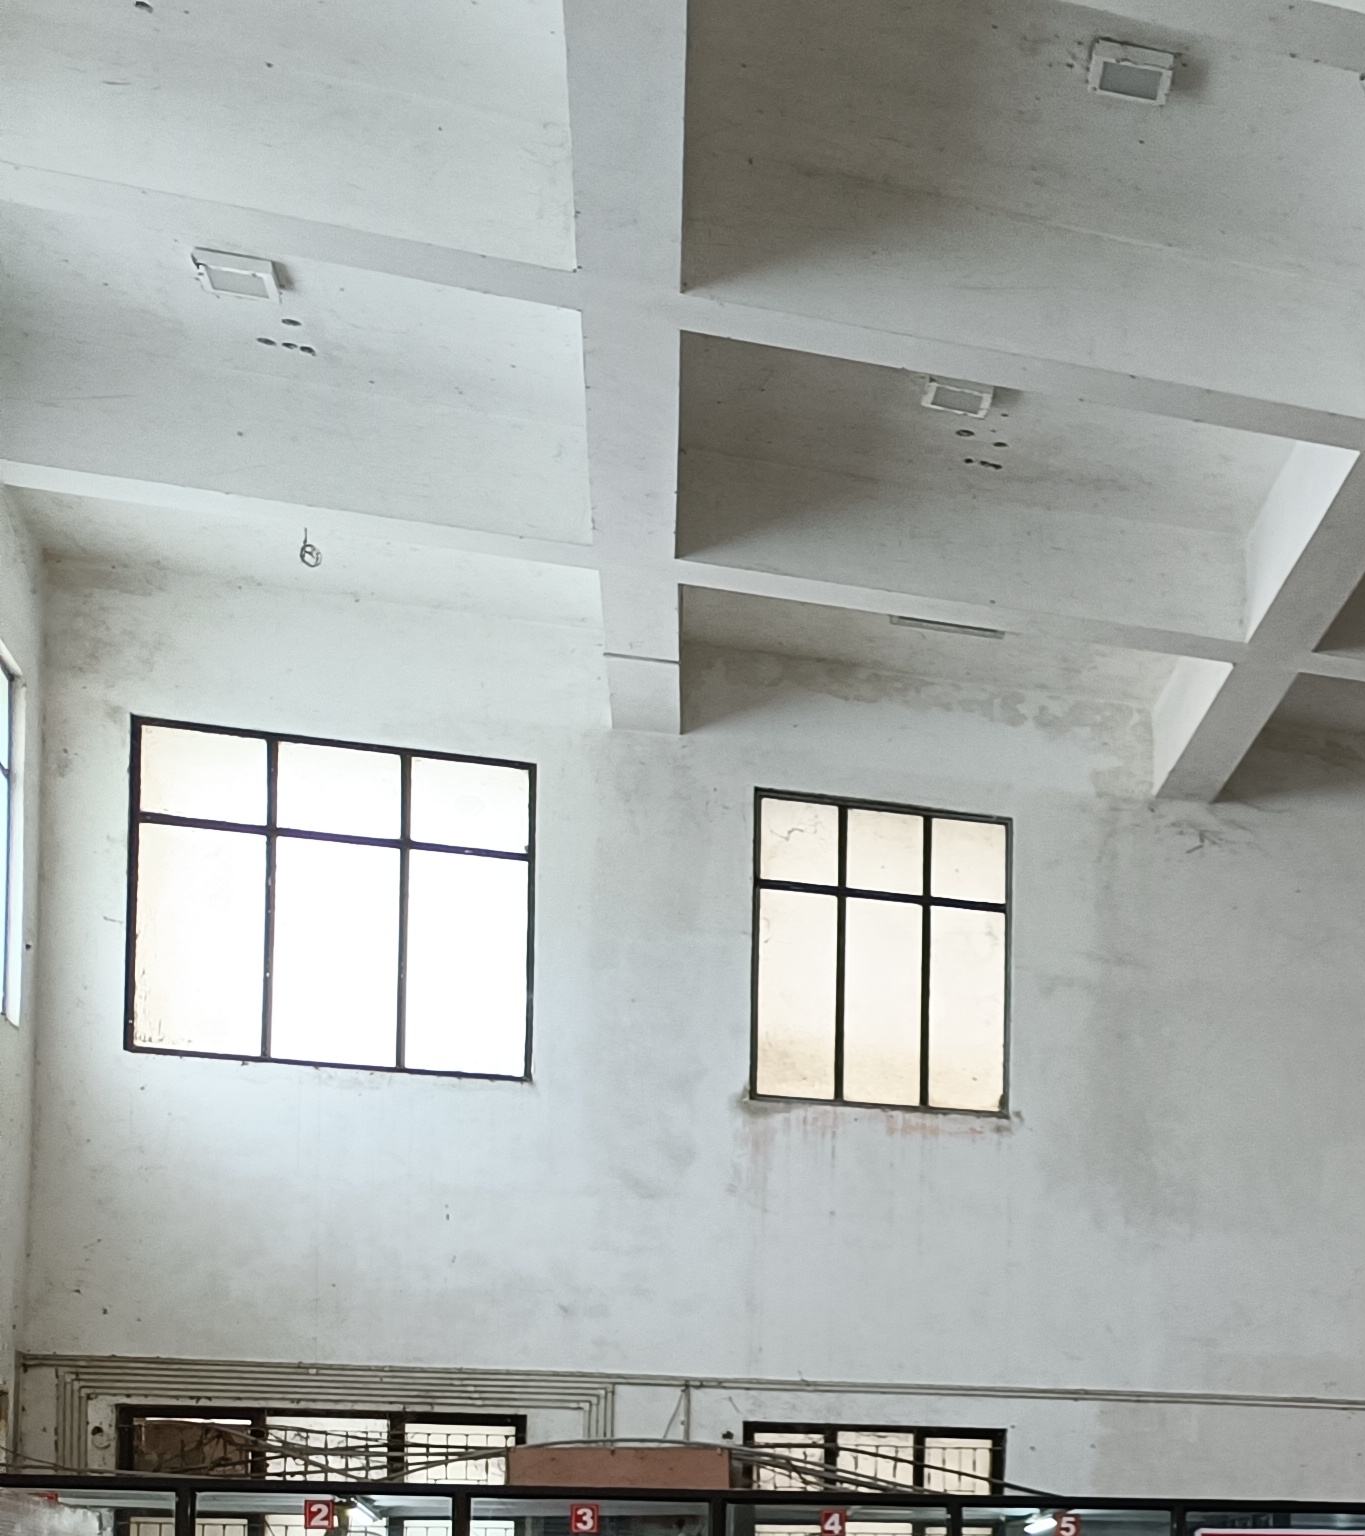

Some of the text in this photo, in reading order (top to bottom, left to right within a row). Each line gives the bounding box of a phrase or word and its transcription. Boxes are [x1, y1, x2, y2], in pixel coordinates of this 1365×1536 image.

[310, 1503, 329, 1526] 2
[576, 1508, 594, 1531] 3
[824, 1513, 842, 1534] 4
[1059, 1516, 1076, 1536] 5
